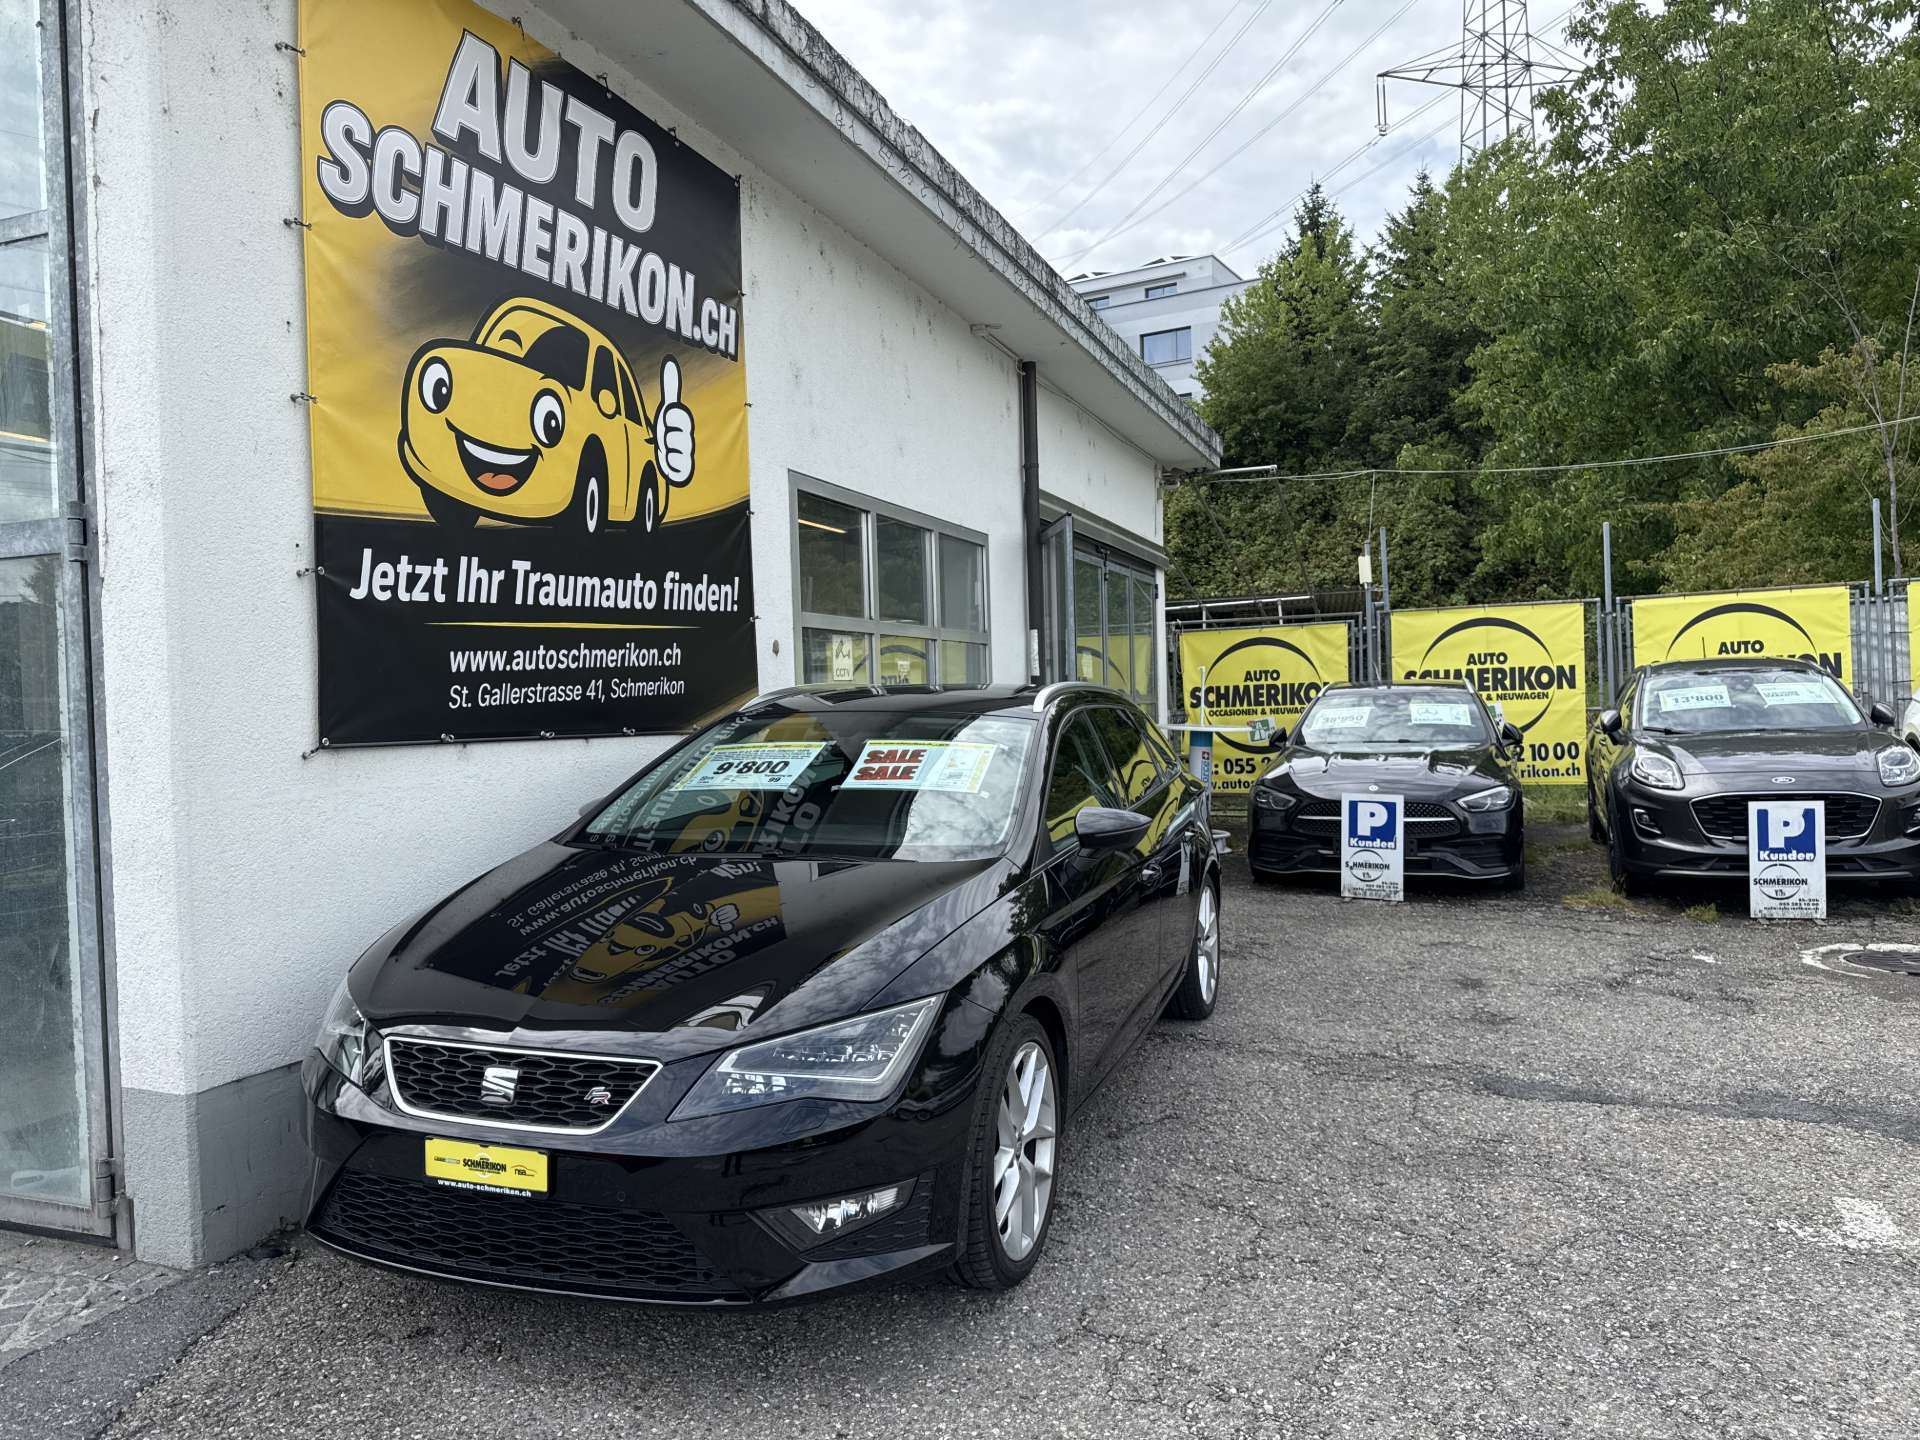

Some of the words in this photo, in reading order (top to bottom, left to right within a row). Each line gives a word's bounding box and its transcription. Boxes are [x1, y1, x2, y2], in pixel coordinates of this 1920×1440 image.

[431, 29, 659, 233] AUTO
[318, 102, 739, 358] SCHMERIKON.CH
[349, 547, 448, 603] Jetzt
[456, 555, 505, 605] Ihr
[512, 559, 657, 610] Traumauto
[663, 575, 740, 613] finden!
[1718, 639, 1765, 656] AUTO
[449, 643, 682, 673] www.autoschmerikon.ch
[1466, 652, 1508, 666] AUTO
[1244, 669, 1281, 683] AUTO
[448, 684, 472, 709] St.
[477, 681, 582, 708] Gallerstrasse
[586, 679, 605, 703] 41,
[610, 677, 685, 699] Schmerikon
[1190, 681, 1330, 709] SCHMERIKO
[1496, 691, 1549, 701] NEUWAGEN
[1208, 708, 1258, 717] OCCASIONEN
[1269, 706, 1305, 715] NEUWAG
[863, 749, 928, 764] SALE
[713, 760, 790, 775] 9'800
[853, 765, 920, 781] SALE
[1223, 757, 1257, 775] 055
[1358, 802, 1388, 836] P
[1350, 837, 1396, 849] Kunden
[1759, 849, 1815, 861] Kunden
[1753, 878, 1808, 886] SCHMERIKON
[463, 1158, 507, 1173] SCHMERIKON
[438, 1179, 532, 1198] www.auto-schmerikon.ch
